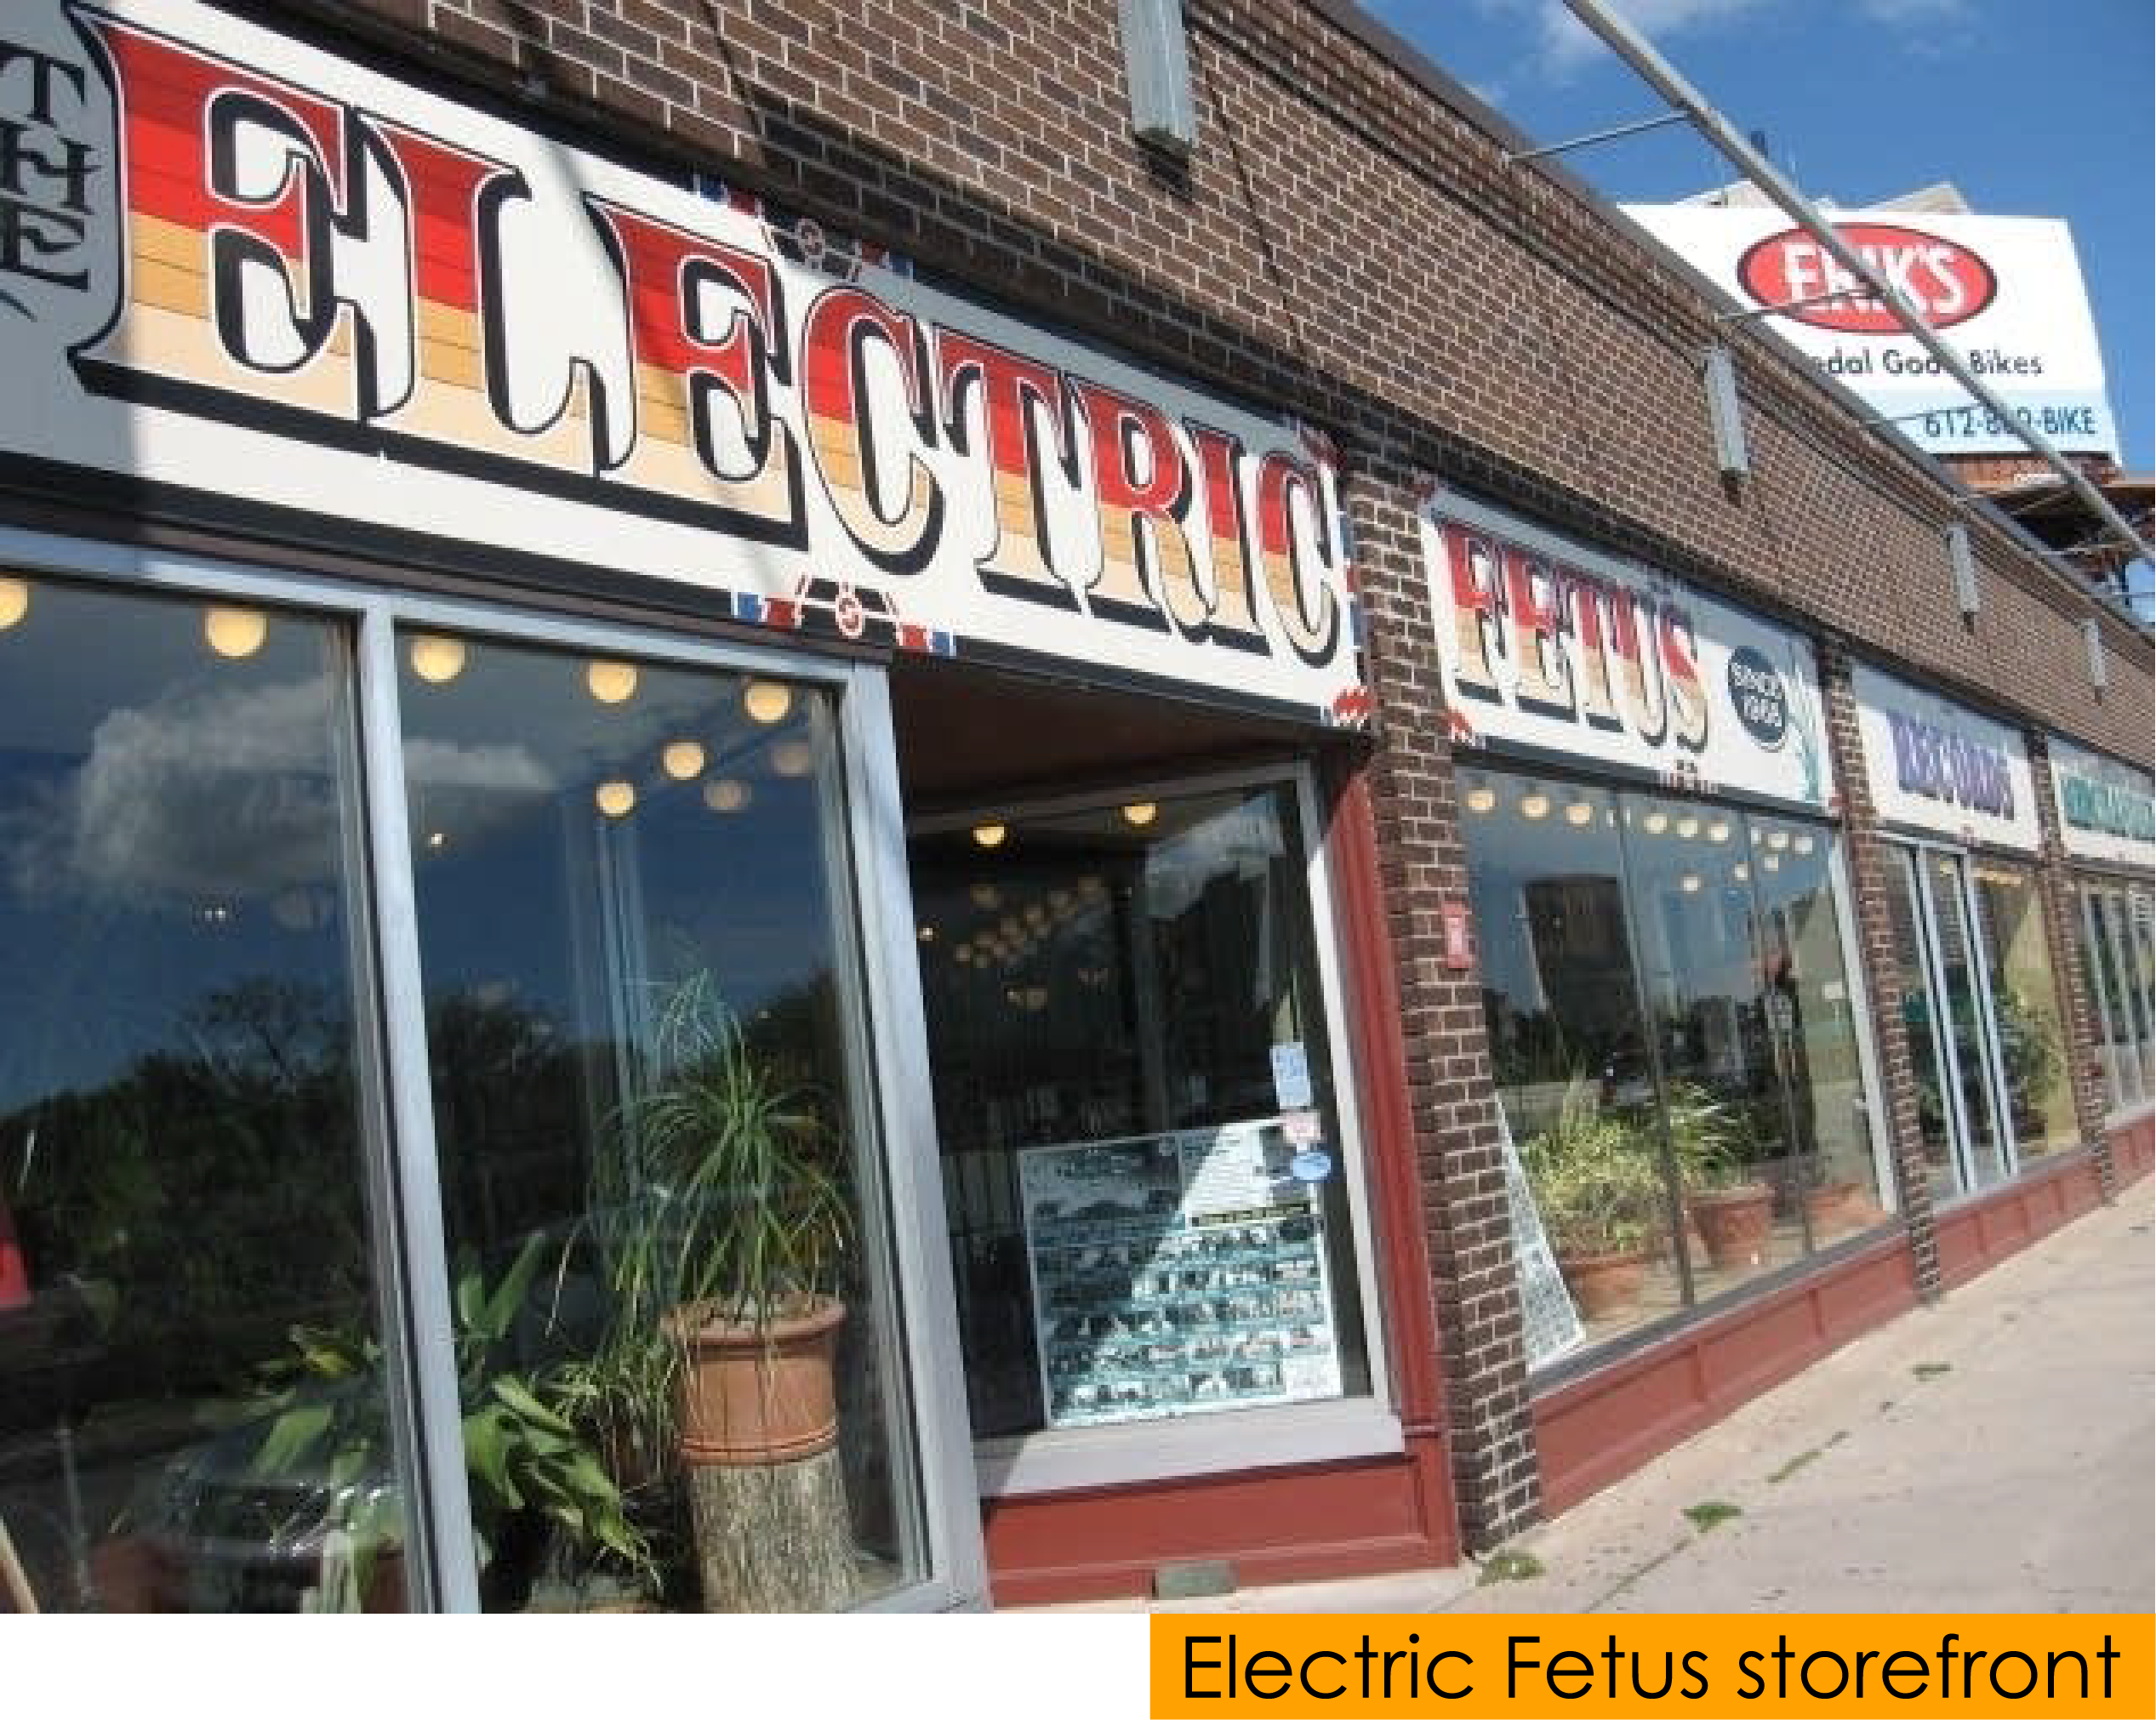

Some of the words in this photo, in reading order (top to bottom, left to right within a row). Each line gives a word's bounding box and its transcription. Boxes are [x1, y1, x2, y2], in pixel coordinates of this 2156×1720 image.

[61, 3, 1342, 669] ELECTRIC
[1969, 347, 2045, 376] Bikes
[1438, 522, 1708, 754] FETUS
